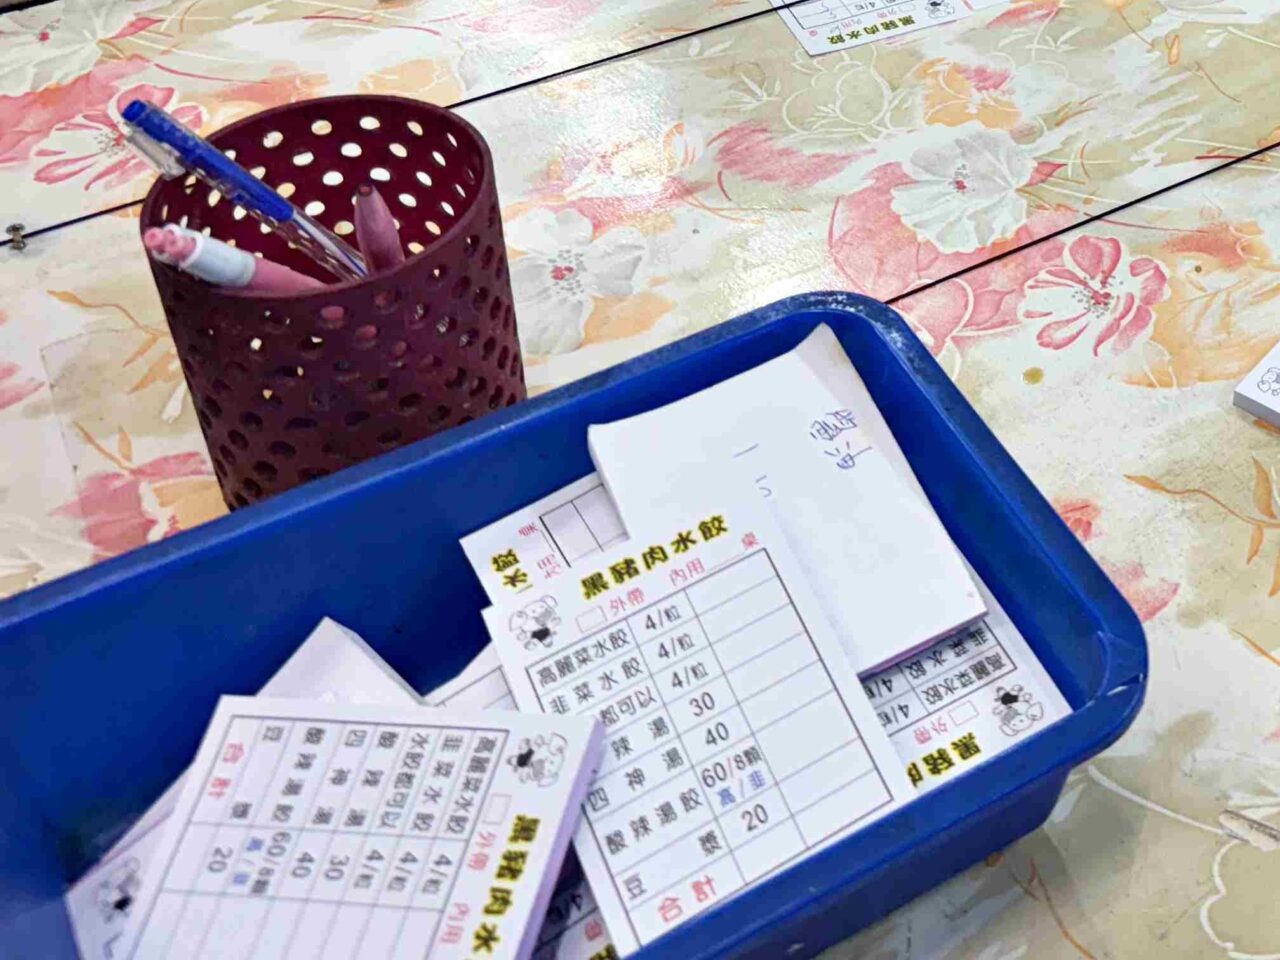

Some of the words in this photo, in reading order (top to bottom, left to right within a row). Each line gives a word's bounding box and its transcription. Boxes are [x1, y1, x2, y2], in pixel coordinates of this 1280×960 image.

[827, 15, 915, 44] 黑豬肉水餃
[581, 515, 727, 599] 黑豬肉水餃
[610, 587, 644, 616] 外帶
[669, 558, 708, 586] 內用
[537, 629, 634, 687] 高麗菜水餃
[646, 606, 681, 629] 4/粒
[549, 653, 647, 715] 韭菜水餃
[658, 633, 695, 659] 4/粒
[598, 690, 656, 728] 都可以
[672, 662, 708, 688] 4/粒
[610, 716, 671, 757] 辣湯
[689, 692, 715, 717] 30
[584, 745, 689, 813] 四神湯
[706, 722, 729, 745] 40
[604, 788, 706, 855] 酸辣湯餃
[696, 738, 766, 794] 60/8顆
[741, 804, 768, 832] 20
[464, 814, 541, 960] 黑豬肉水
[658, 875, 716, 923] 合計
